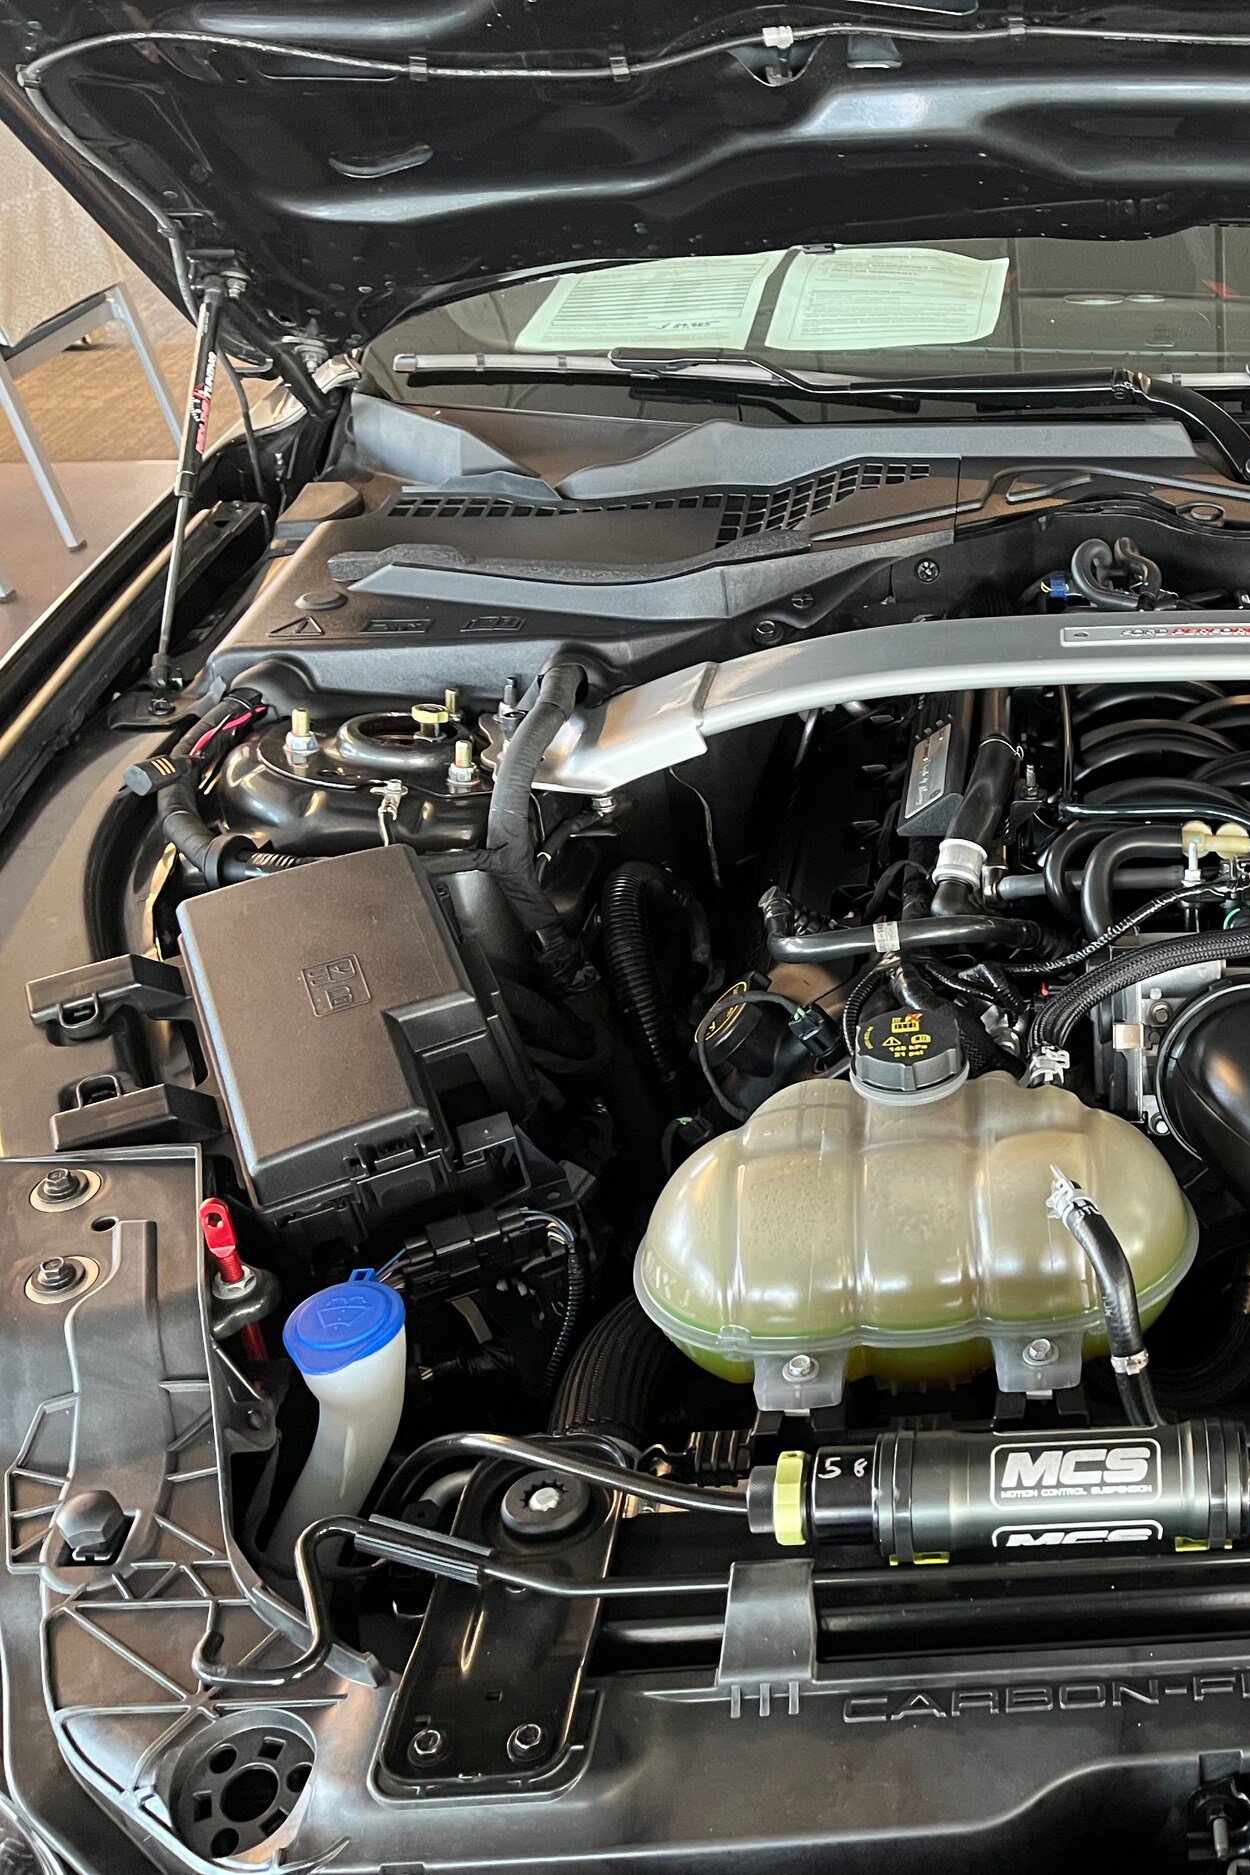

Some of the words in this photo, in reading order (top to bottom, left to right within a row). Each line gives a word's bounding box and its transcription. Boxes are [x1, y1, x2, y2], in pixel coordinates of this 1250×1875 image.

[1120, 628, 1168, 638] FORD
[817, 1456, 842, 1479] 5
[1001, 1447, 1151, 1489] MCS
[1000, 1489, 1039, 1499] MOTION
[1040, 1486, 1088, 1498] CONTROL
[1090, 1484, 1153, 1496] SUSPENSION
[1005, 1528, 1153, 1547] MCS
